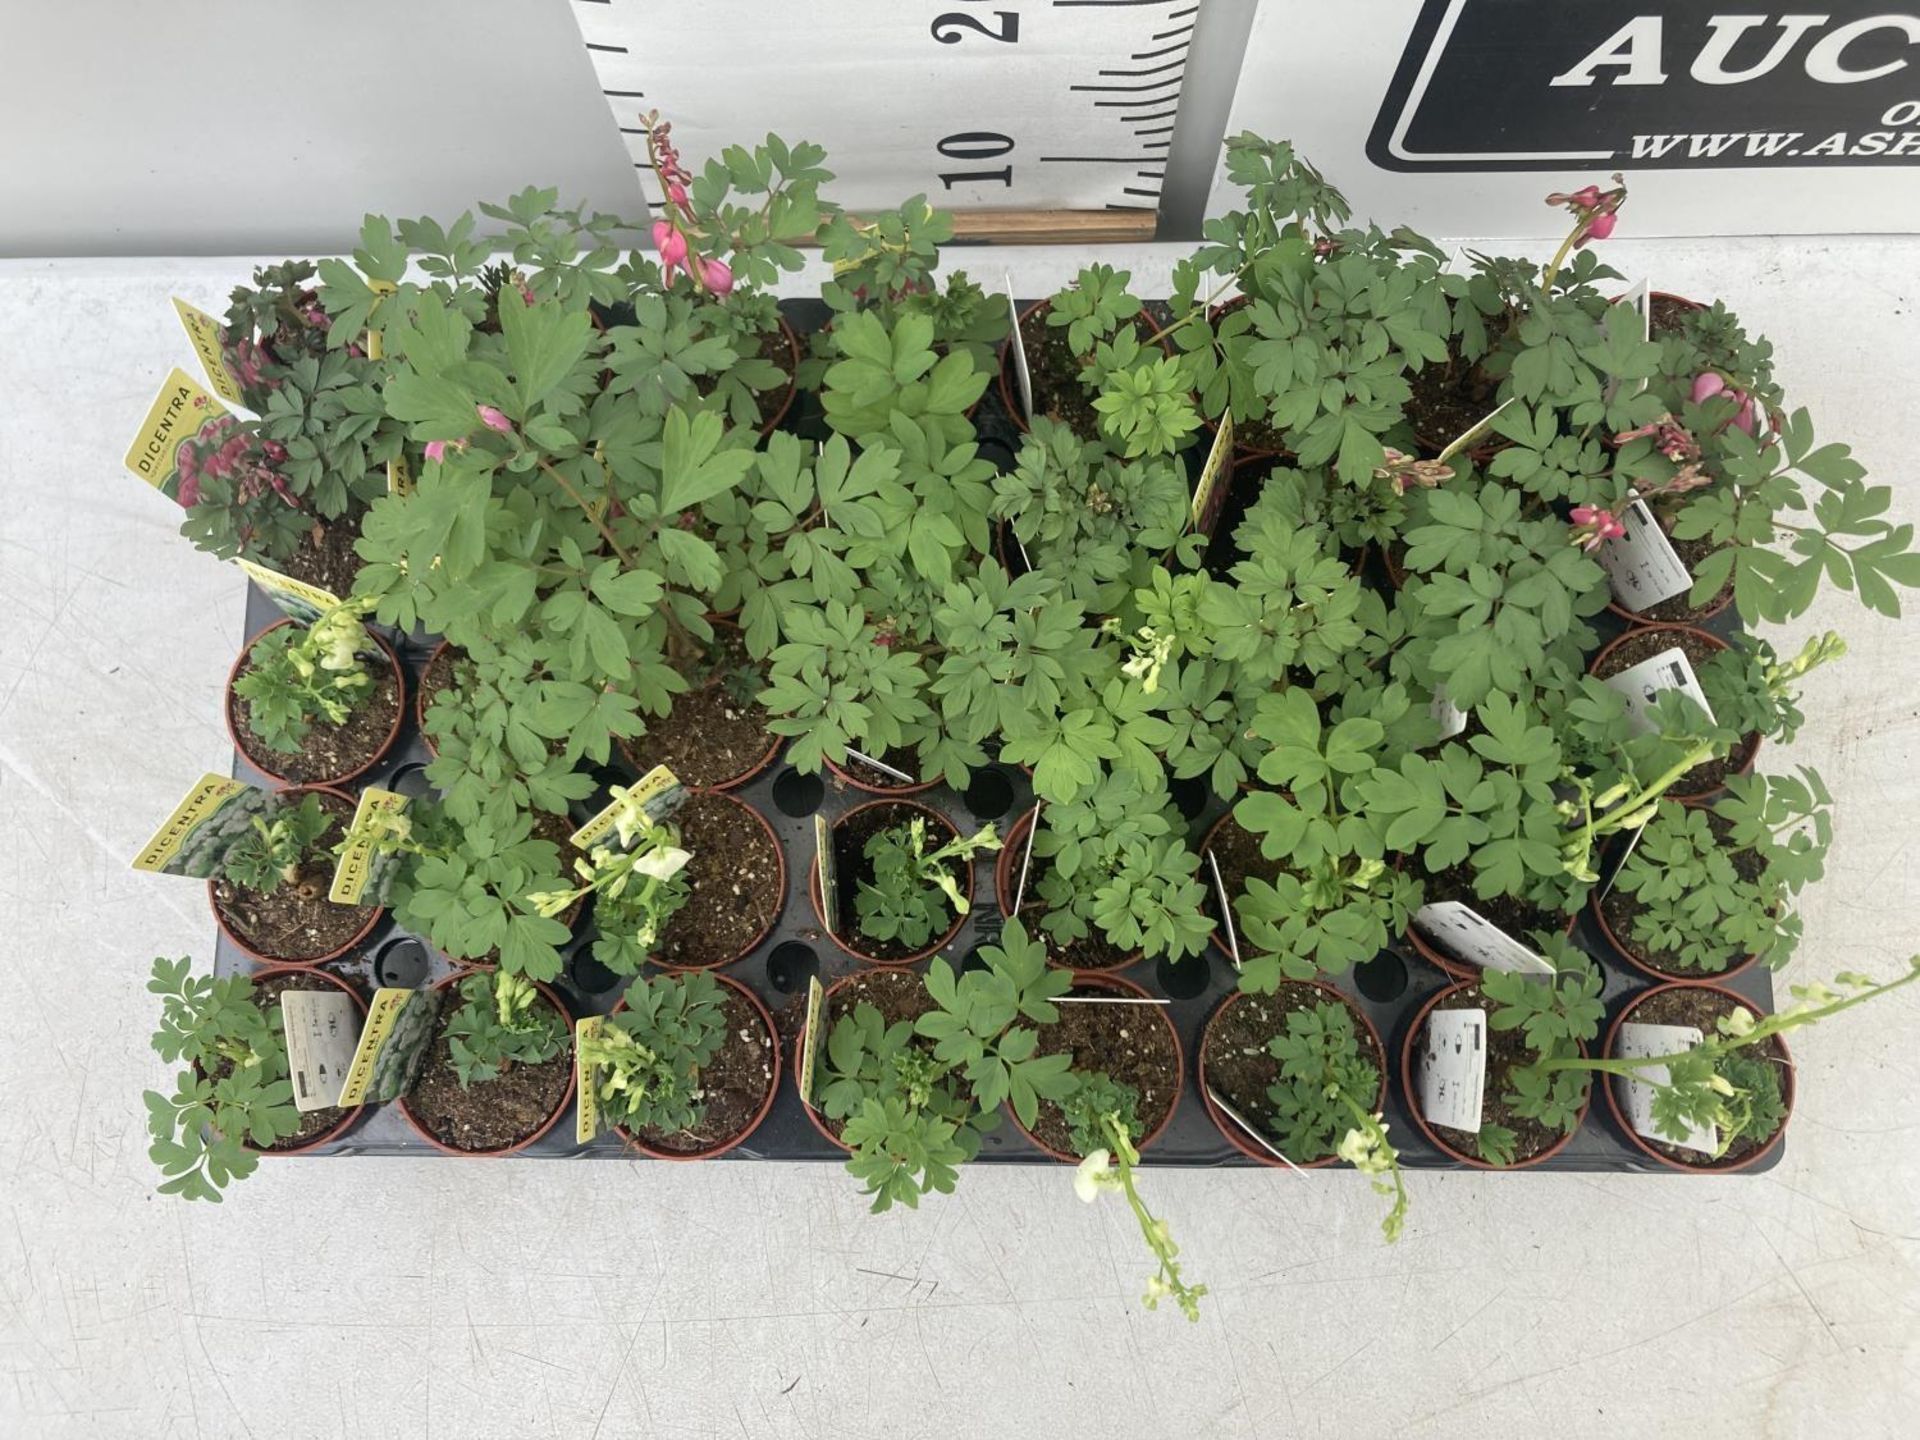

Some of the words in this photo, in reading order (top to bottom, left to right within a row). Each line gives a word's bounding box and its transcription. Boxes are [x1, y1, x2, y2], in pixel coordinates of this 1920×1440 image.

[1549, 14, 1920, 86] AUC
[936, 132, 1015, 190] 10
[138, 386, 191, 473] DICENTRA
[144, 784, 216, 865] DICENTRA
[348, 999, 388, 1099] DICENTRA
